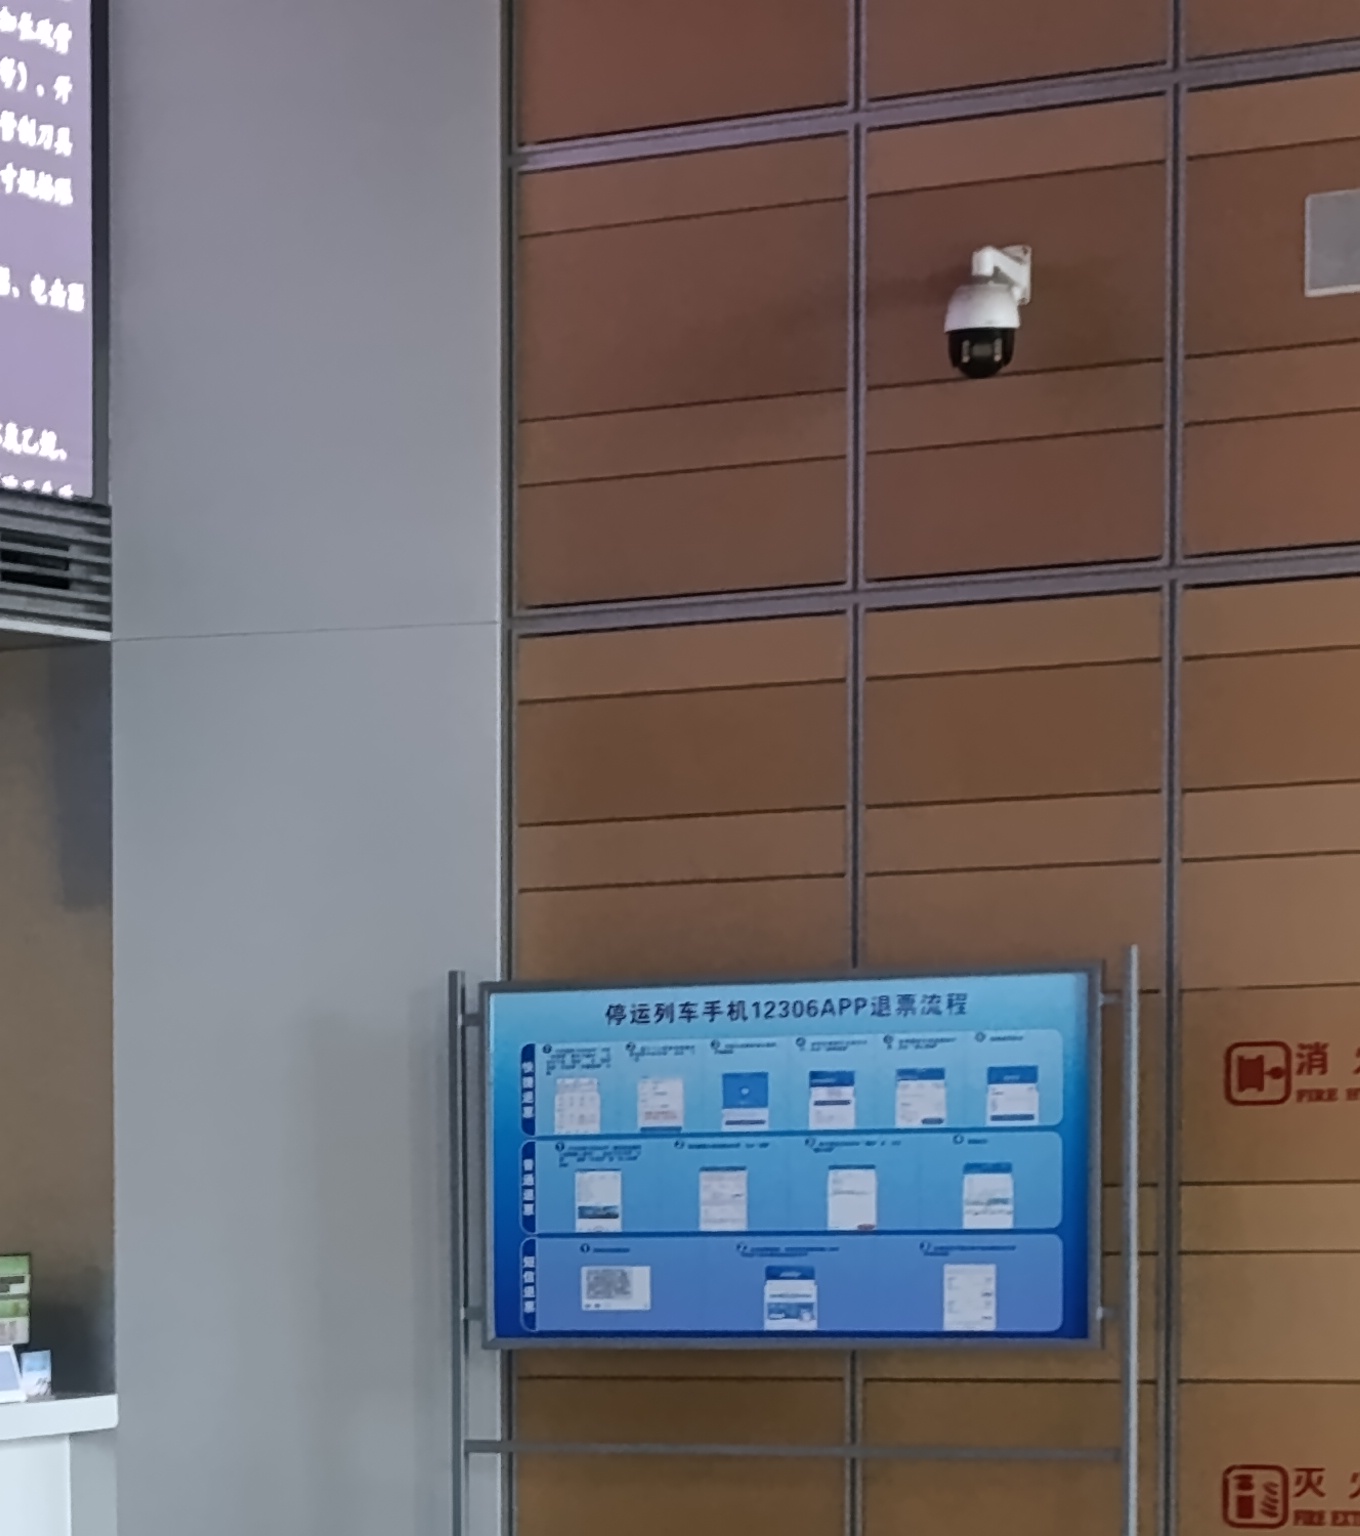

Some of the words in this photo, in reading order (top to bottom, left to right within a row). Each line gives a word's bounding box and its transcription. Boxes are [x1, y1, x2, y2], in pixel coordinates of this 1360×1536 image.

[604, 991, 970, 1028] 停运列车手机12306APP退票流程
